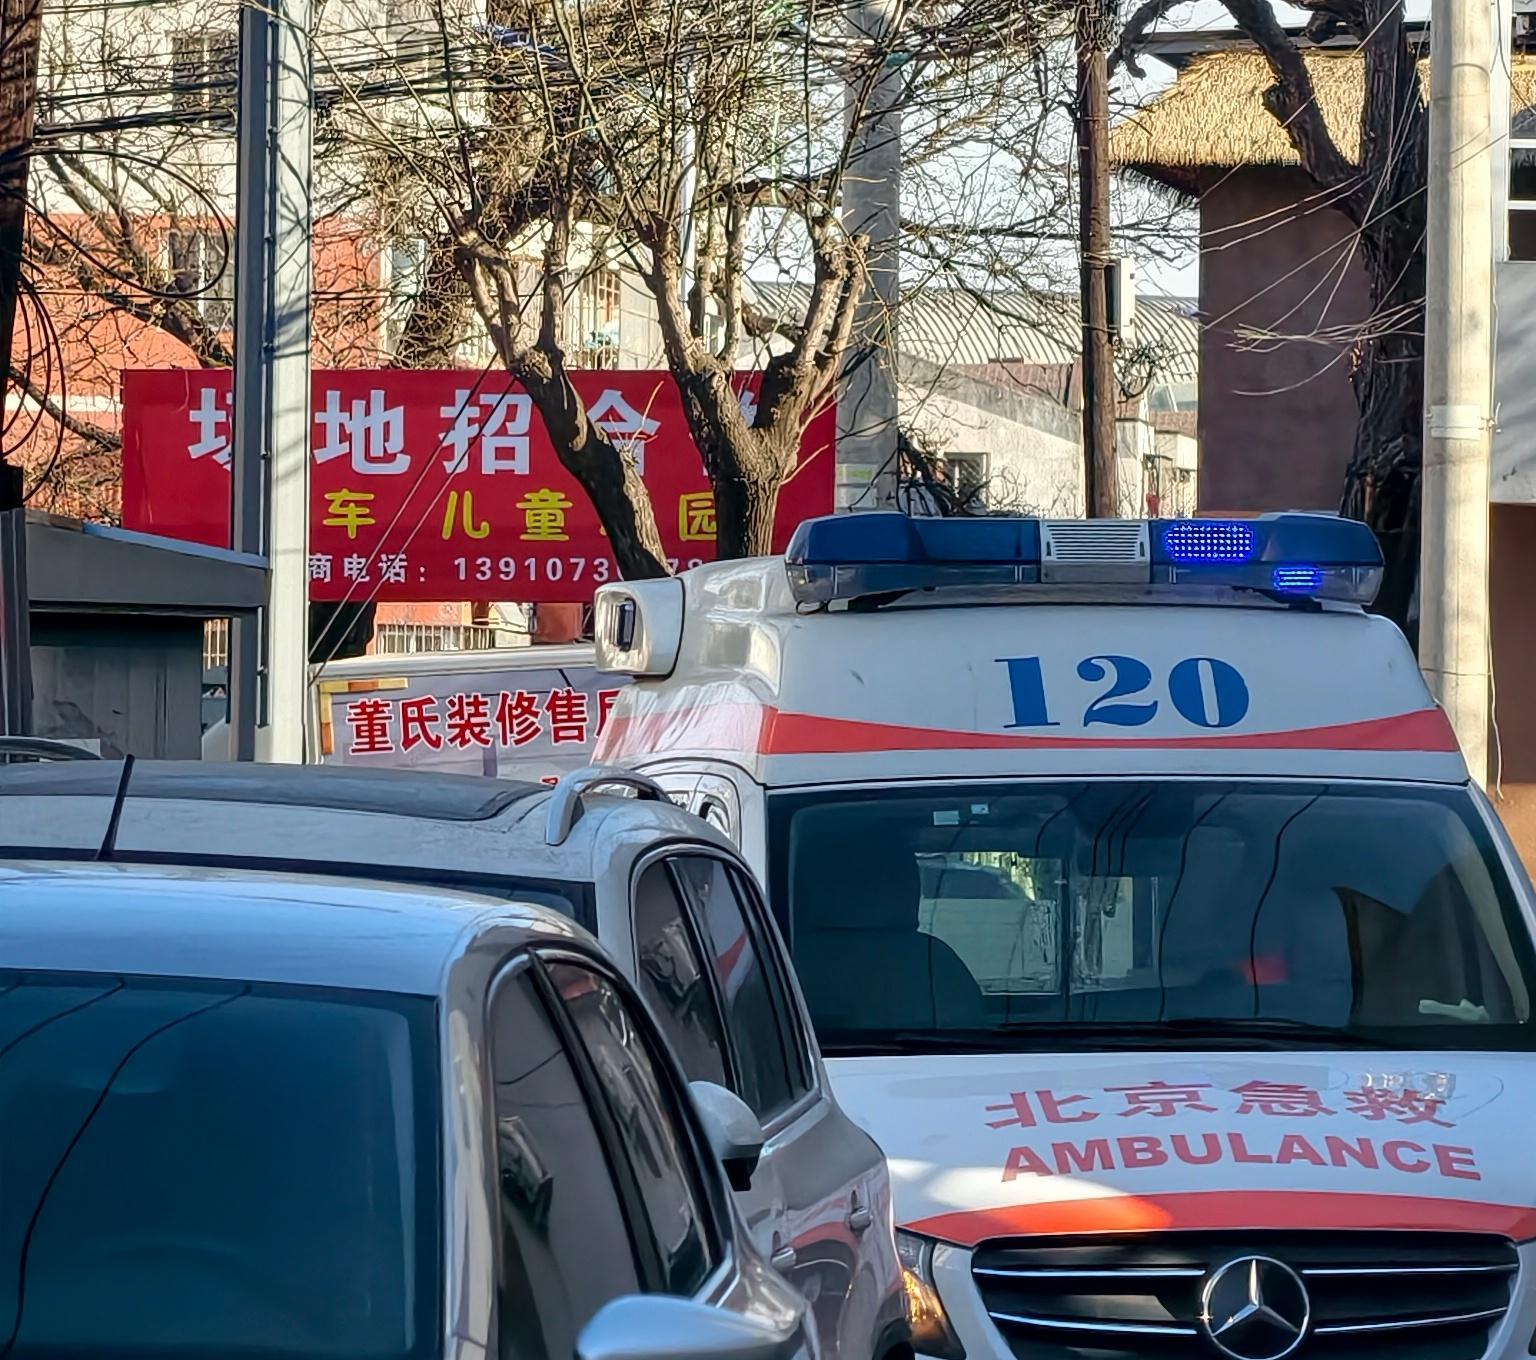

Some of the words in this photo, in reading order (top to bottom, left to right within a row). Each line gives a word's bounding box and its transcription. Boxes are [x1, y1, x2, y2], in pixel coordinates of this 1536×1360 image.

[188, 387, 757, 477] 地招合
[441, 488, 717, 542] 儿童园
[994, 655, 1250, 728] 120
[985, 1080, 1457, 1129] 北京急救
[1001, 1132, 1482, 1182] AMBULANCE
